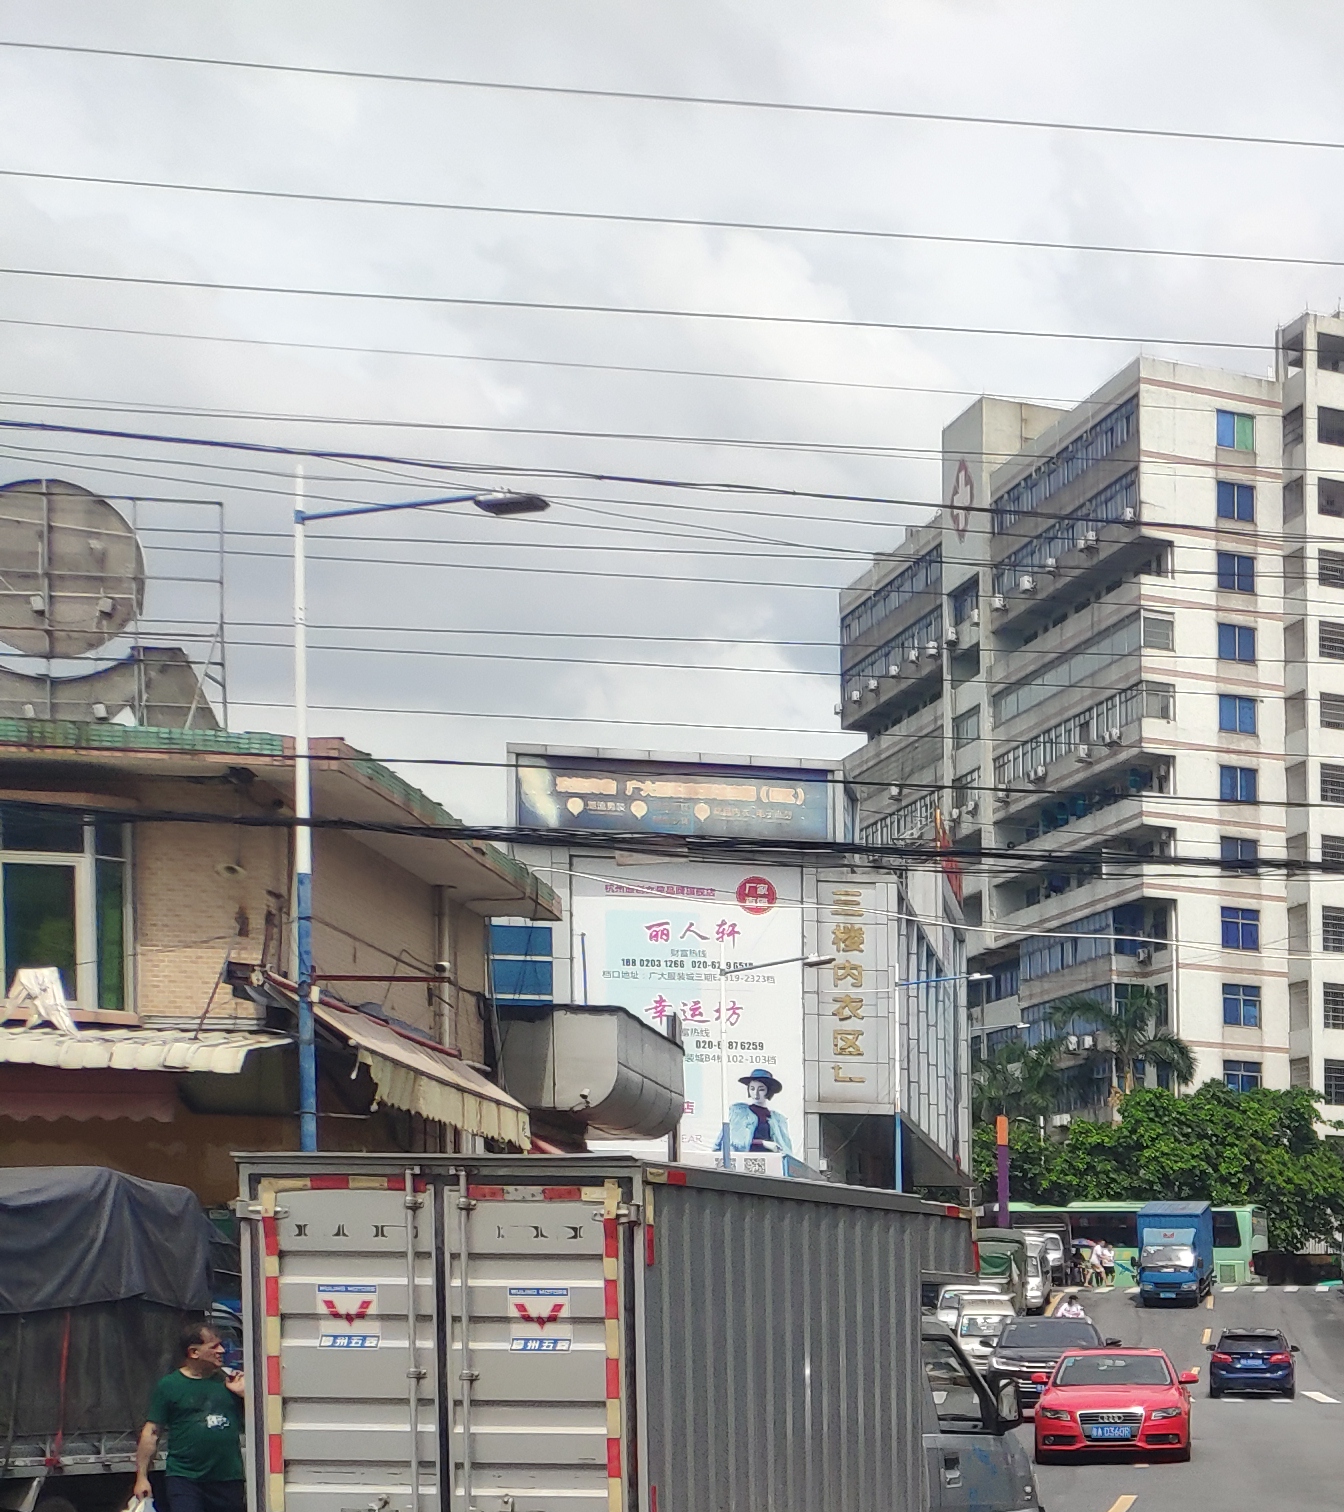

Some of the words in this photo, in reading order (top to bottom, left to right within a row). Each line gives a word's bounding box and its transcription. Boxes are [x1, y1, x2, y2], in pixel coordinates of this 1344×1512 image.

[644, 919, 742, 949] 丽人轩
[621, 958, 637, 968] 188
[639, 959, 662, 968] 0203
[664, 959, 685, 968] 1266
[830, 889, 865, 1056] 三楼内衣区
[644, 994, 744, 1026] 幸运坊
